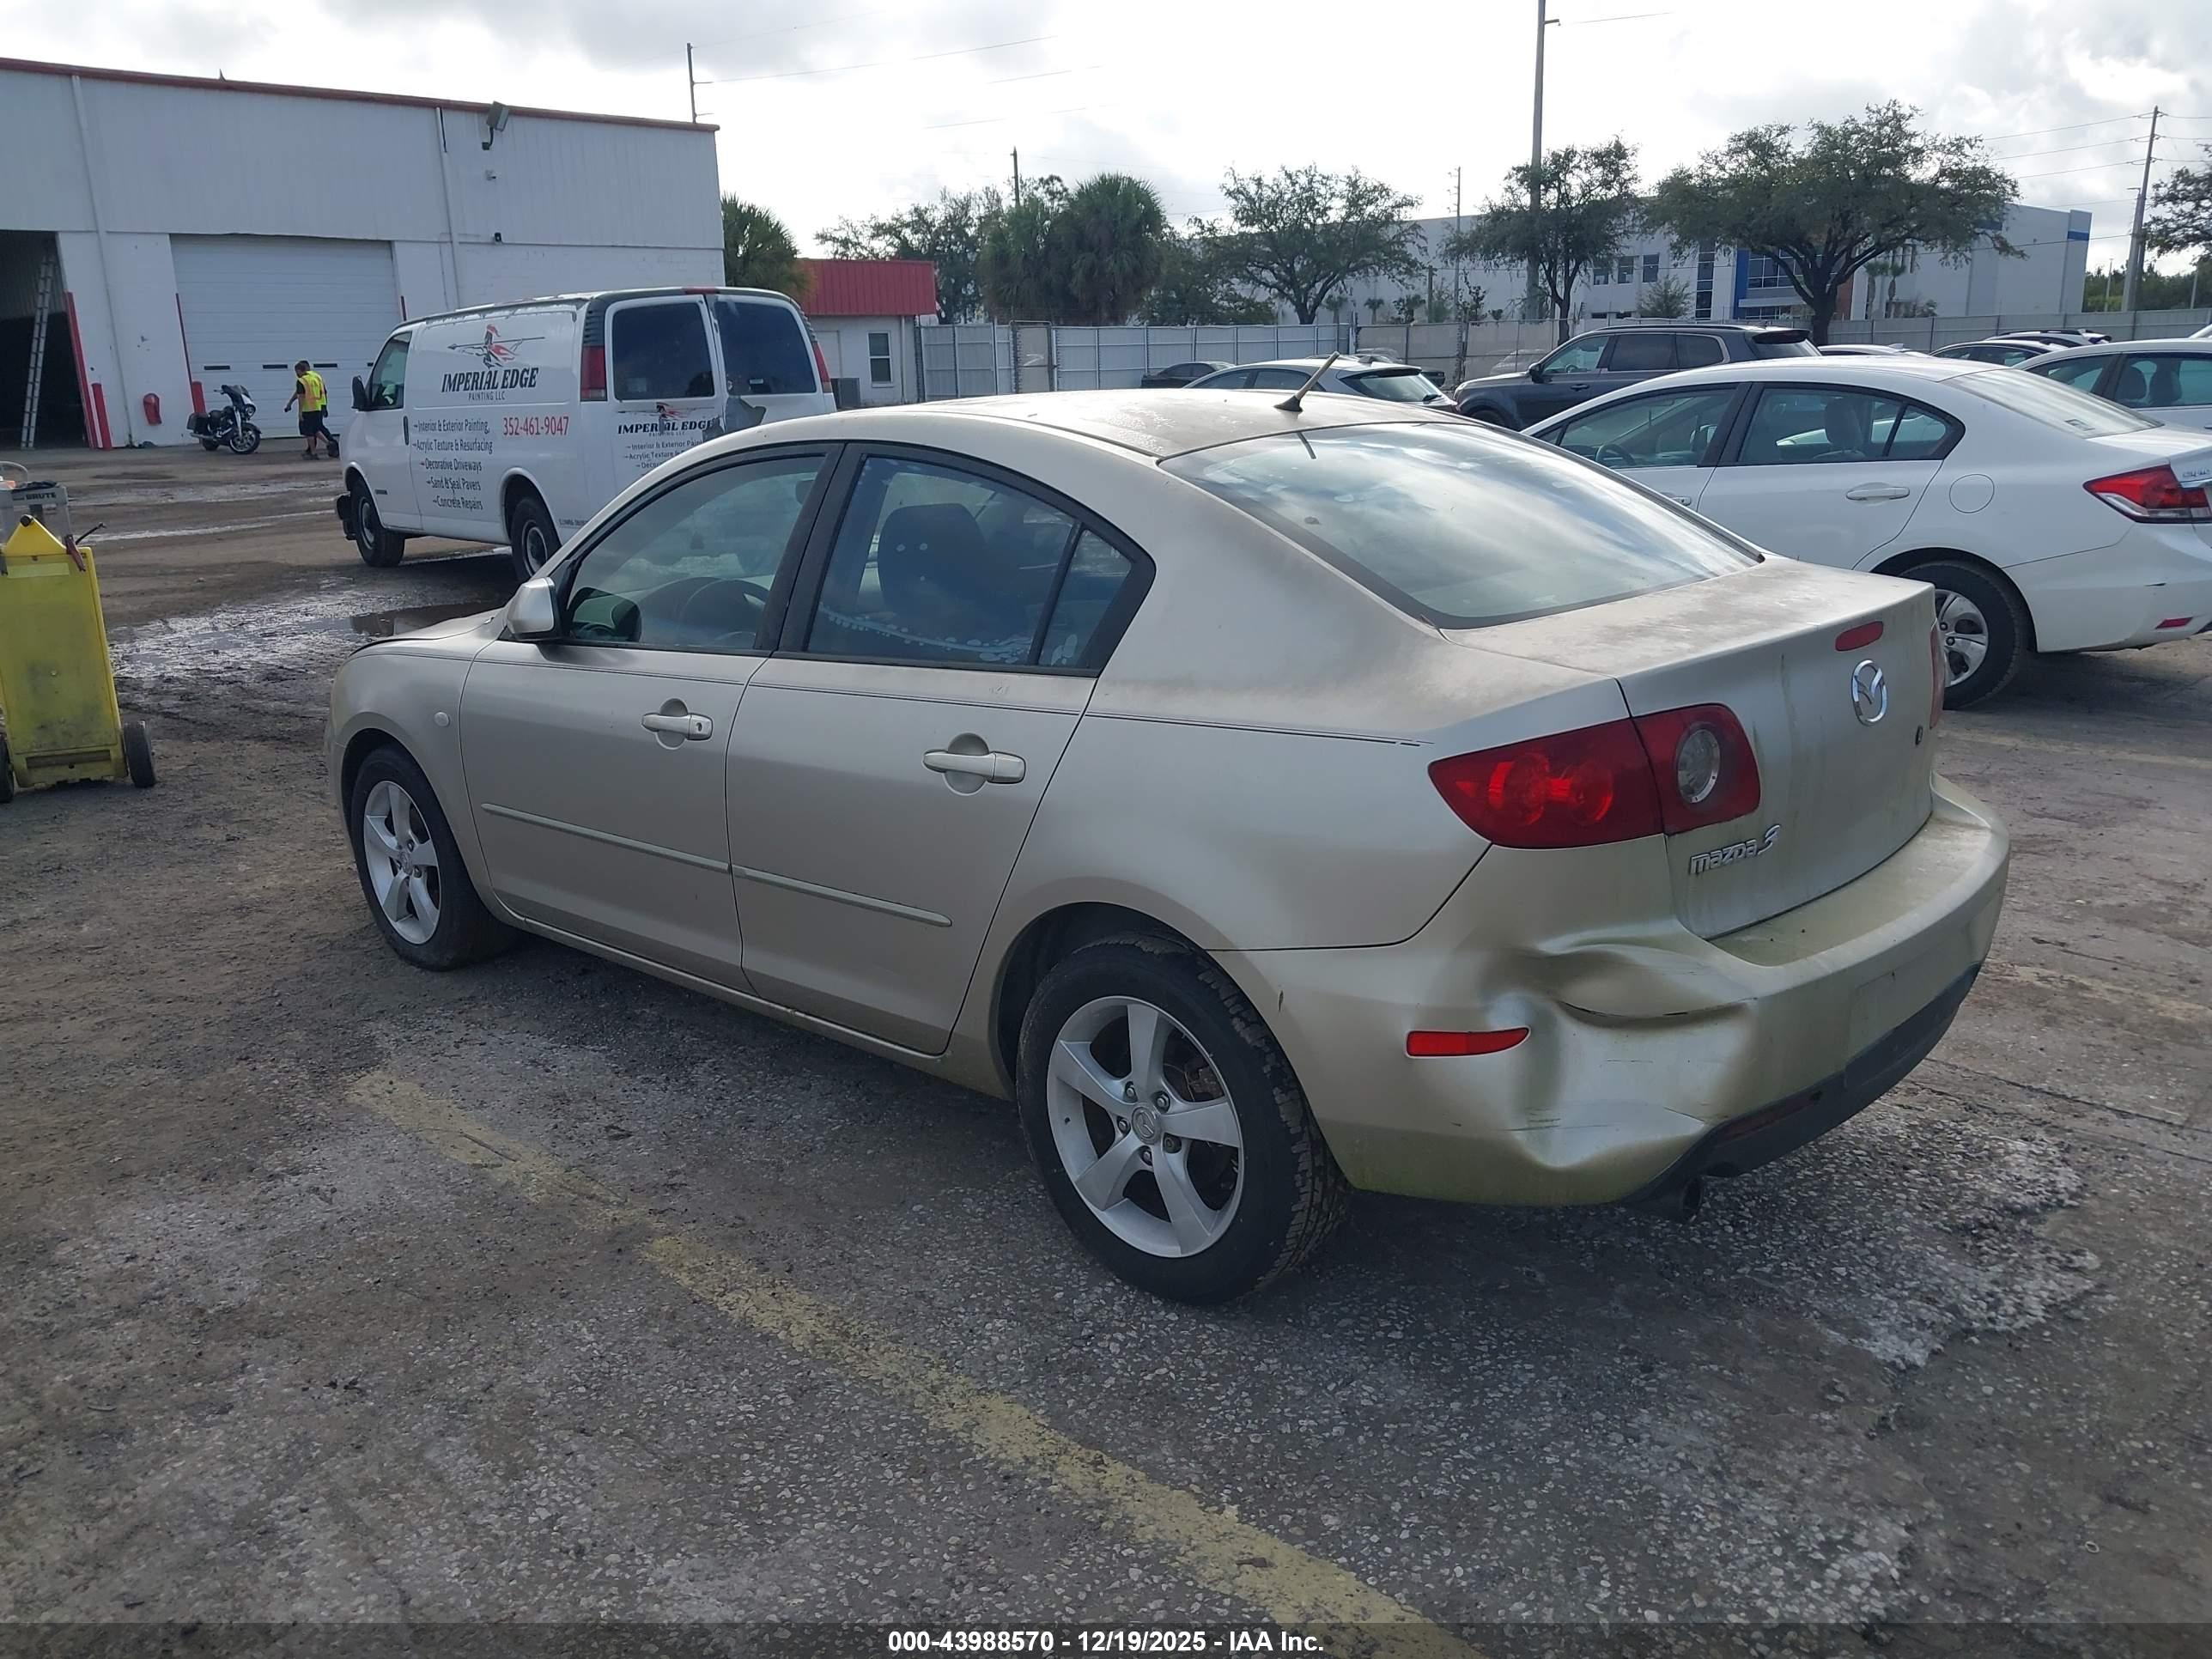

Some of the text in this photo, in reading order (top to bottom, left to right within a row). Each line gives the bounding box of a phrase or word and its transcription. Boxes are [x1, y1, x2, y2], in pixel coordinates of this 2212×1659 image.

[441, 368, 538, 392] IMPERIAL EDGE
[468, 391, 506, 401] PAINTING LLC
[438, 419, 442, 431] &
[442, 419, 464, 431] Exterior
[503, 416, 570, 436] 352-461-9047
[617, 422, 678, 434] IMPERAL
[434, 439, 453, 452] Texture
[454, 439, 459, 452] &
[459, 438, 493, 454] Resurfacing
[453, 459, 482, 474] Driveways
[449, 477, 461, 489] Seal
[461, 477, 482, 491] Pavers
[26, 491, 57, 500] BRUTE
[461, 496, 483, 512] Repairs
